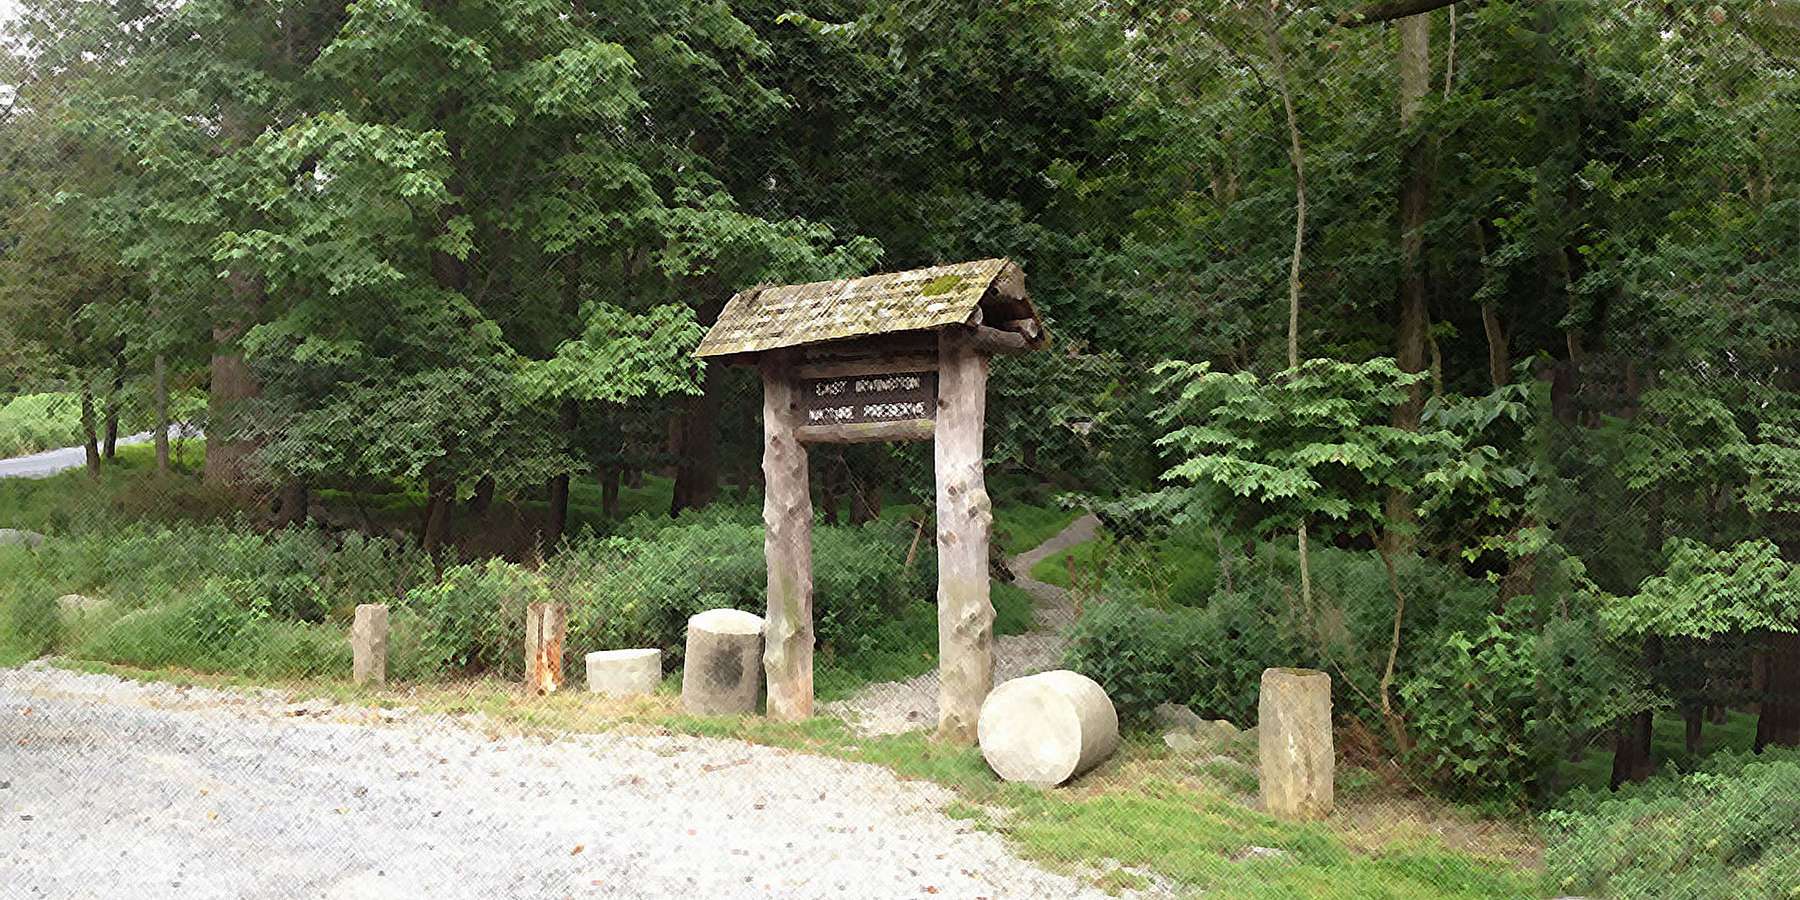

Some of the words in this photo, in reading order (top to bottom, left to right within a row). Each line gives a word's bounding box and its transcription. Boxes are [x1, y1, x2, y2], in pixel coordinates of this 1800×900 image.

[815, 381, 848, 396] EAST
[809, 405, 854, 422] NATURE
[863, 402, 925, 417] PRESERVE
